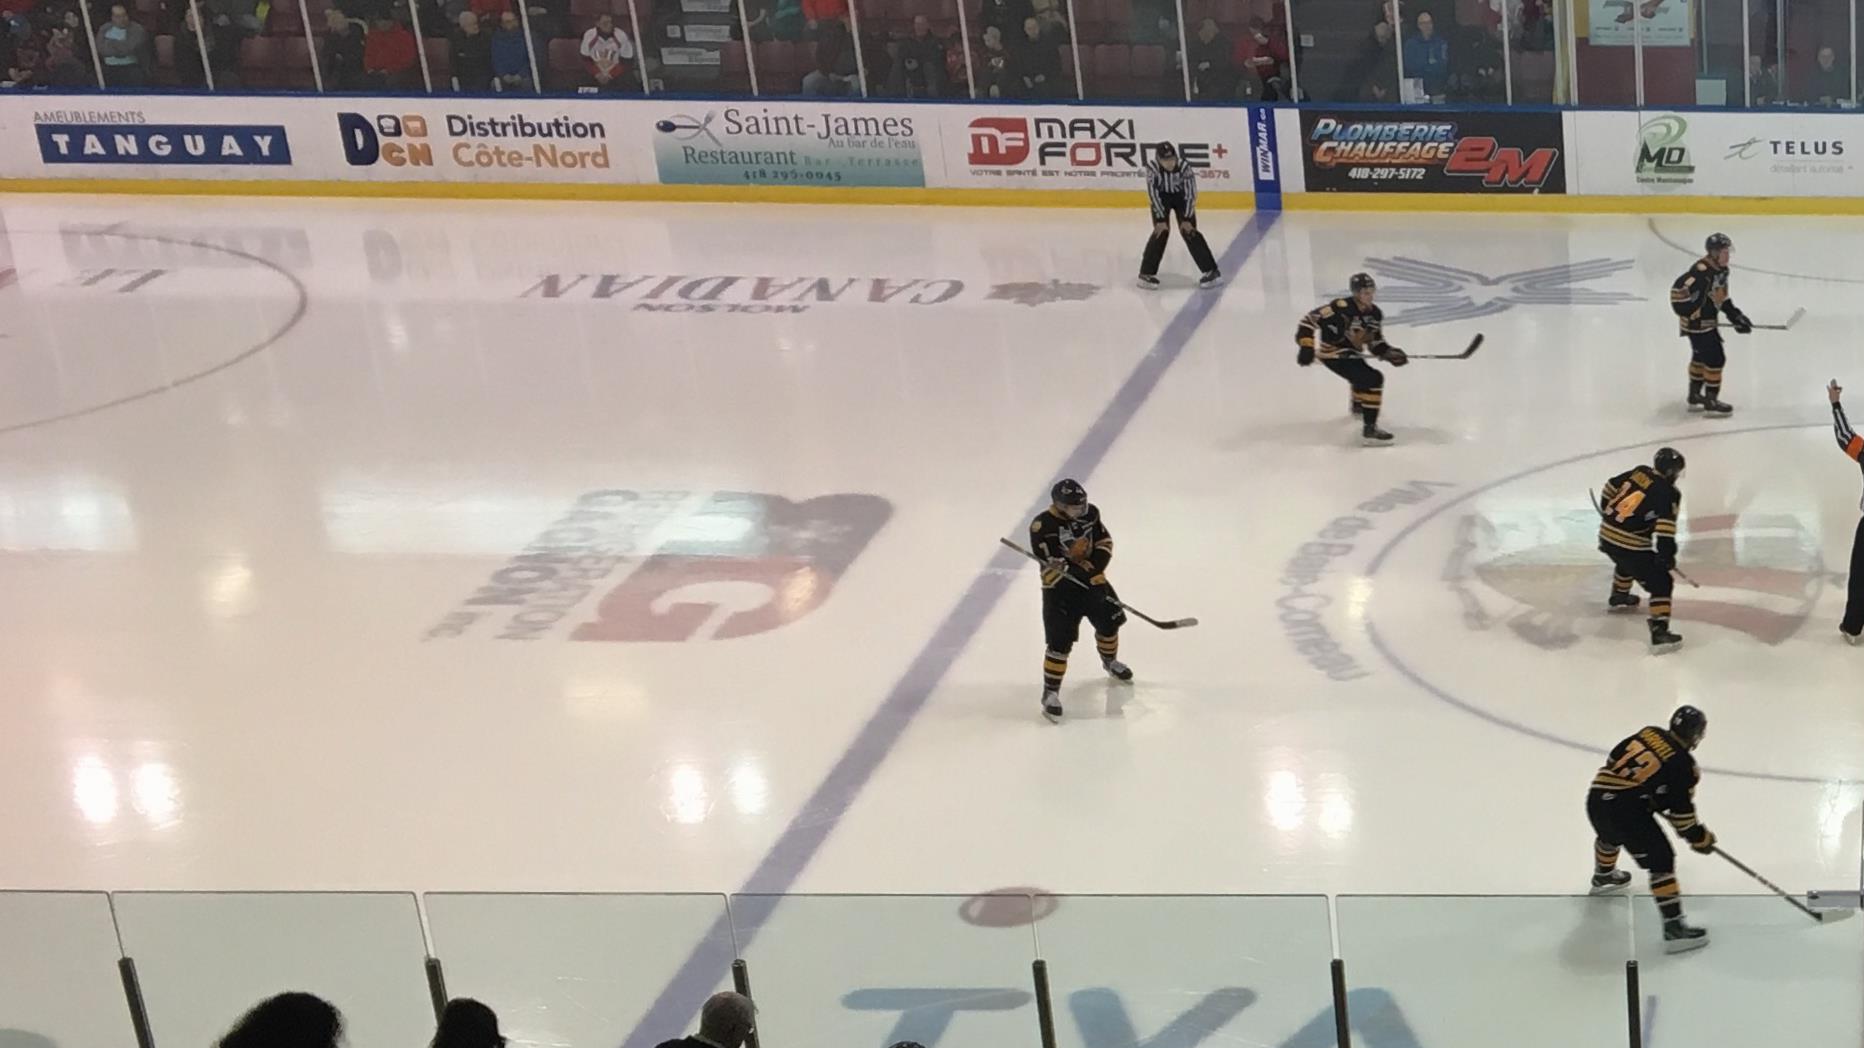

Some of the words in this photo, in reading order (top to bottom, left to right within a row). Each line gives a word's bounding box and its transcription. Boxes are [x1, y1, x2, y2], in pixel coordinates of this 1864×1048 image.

[34, 111, 146, 123] AMEUBLEMENTS
[446, 114, 605, 138] Distribution
[724, 108, 914, 139] Saint-James
[1034, 118, 1135, 139] MAXI
[1312, 118, 1453, 141] PLOMBERIE
[51, 134, 272, 156] TANGUAY
[828, 137, 844, 149] Au
[848, 136, 867, 149] bar
[871, 136, 885, 149] de
[1315, 142, 1454, 163] CHAUFFAGE
[1769, 141, 1844, 155] TELUS
[453, 142, 610, 169] Côte-Nord
[682, 146, 797, 165] Restaurant
[1039, 142, 1228, 167] FORE+
[1443, 136, 1558, 187] 2M
[743, 169, 767, 180] 418
[970, 169, 1002, 177] VOTRE
[1006, 168, 1037, 177] SANTÉ
[1042, 169, 1060, 177] EST
[1064, 169, 1097, 178] NOTRE
[1348, 168, 1426, 179] 418-297-5172
[519, 273, 966, 304] CANADIAN
[632, 302, 810, 314] MOLSON
[1605, 481, 1647, 523] 14
